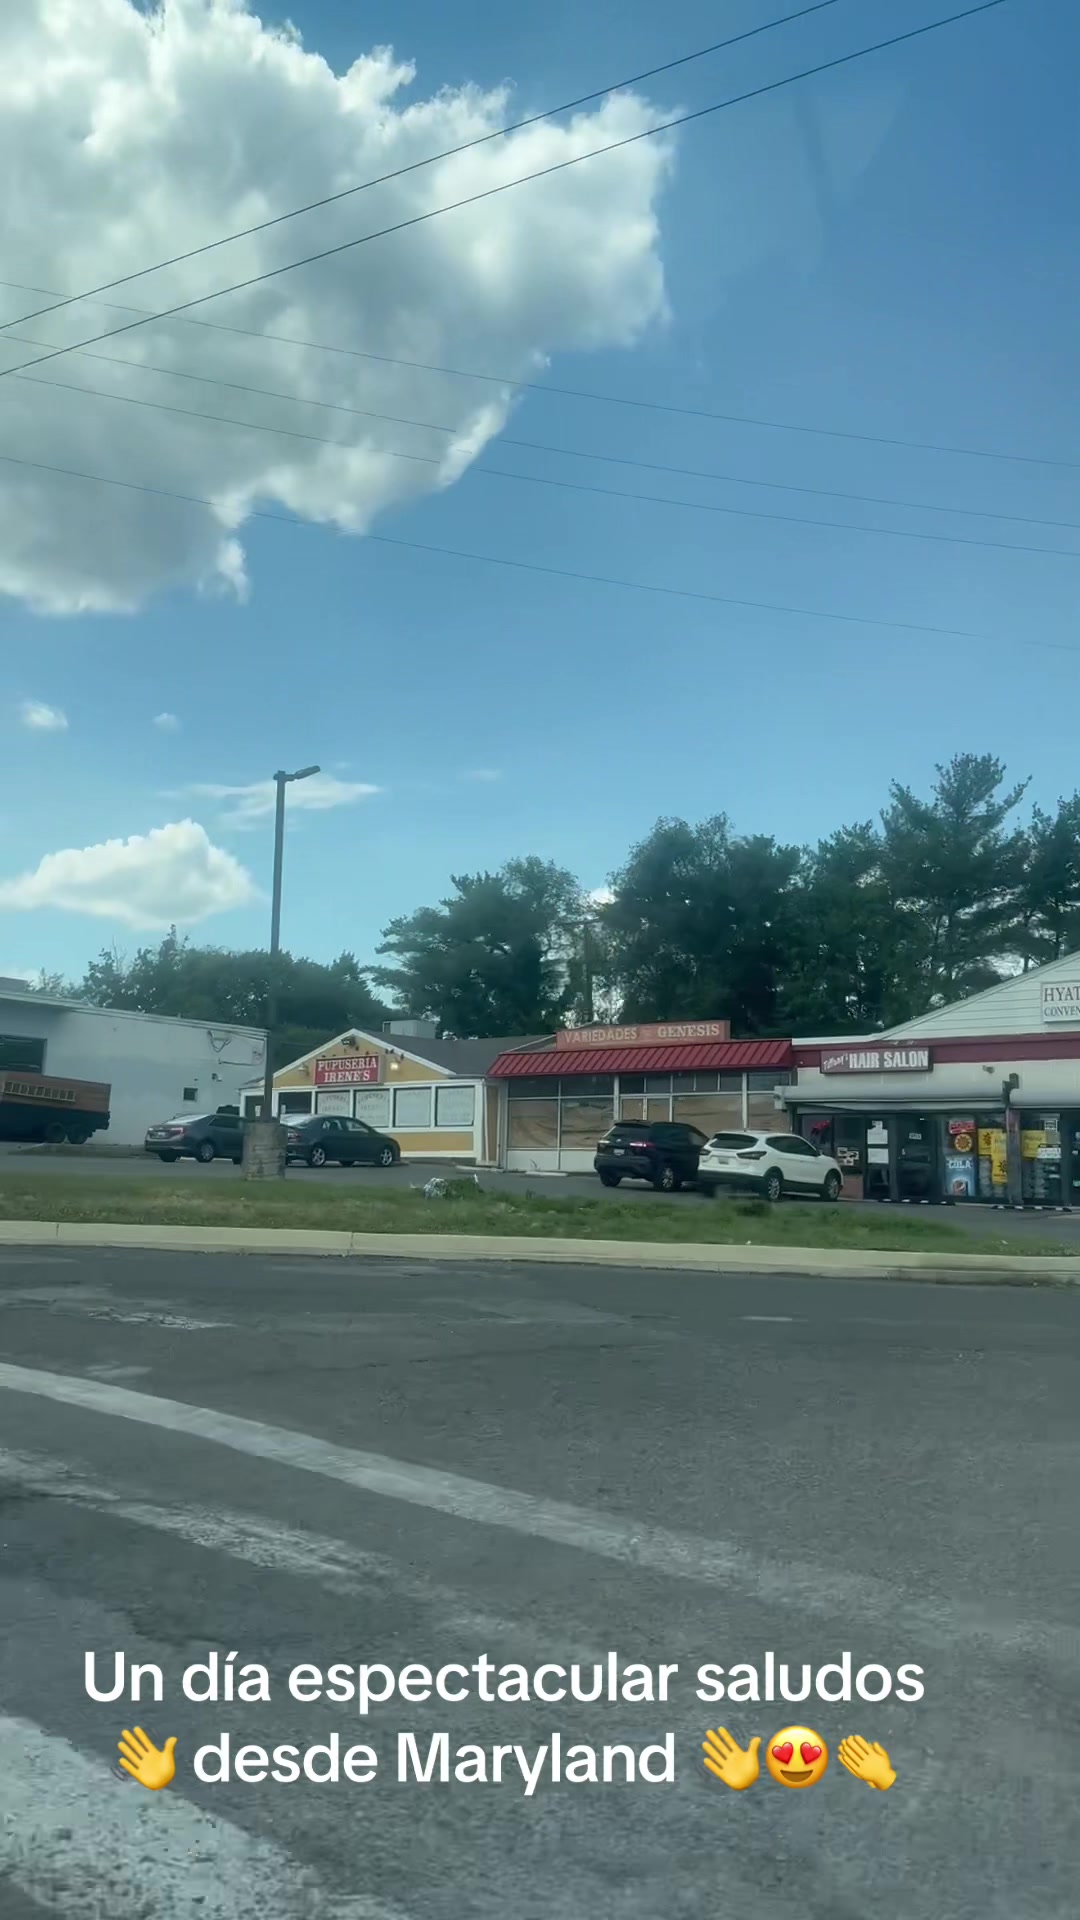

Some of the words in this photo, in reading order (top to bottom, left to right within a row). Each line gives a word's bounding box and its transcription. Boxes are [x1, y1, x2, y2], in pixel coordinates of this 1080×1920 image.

[564, 1027, 638, 1043] VARIEDADES
[657, 1024, 720, 1038] GENESIS
[849, 1052, 880, 1069] HAIR
[884, 1050, 929, 1068] SALON
[324, 1070, 370, 1083] IRENE'S
